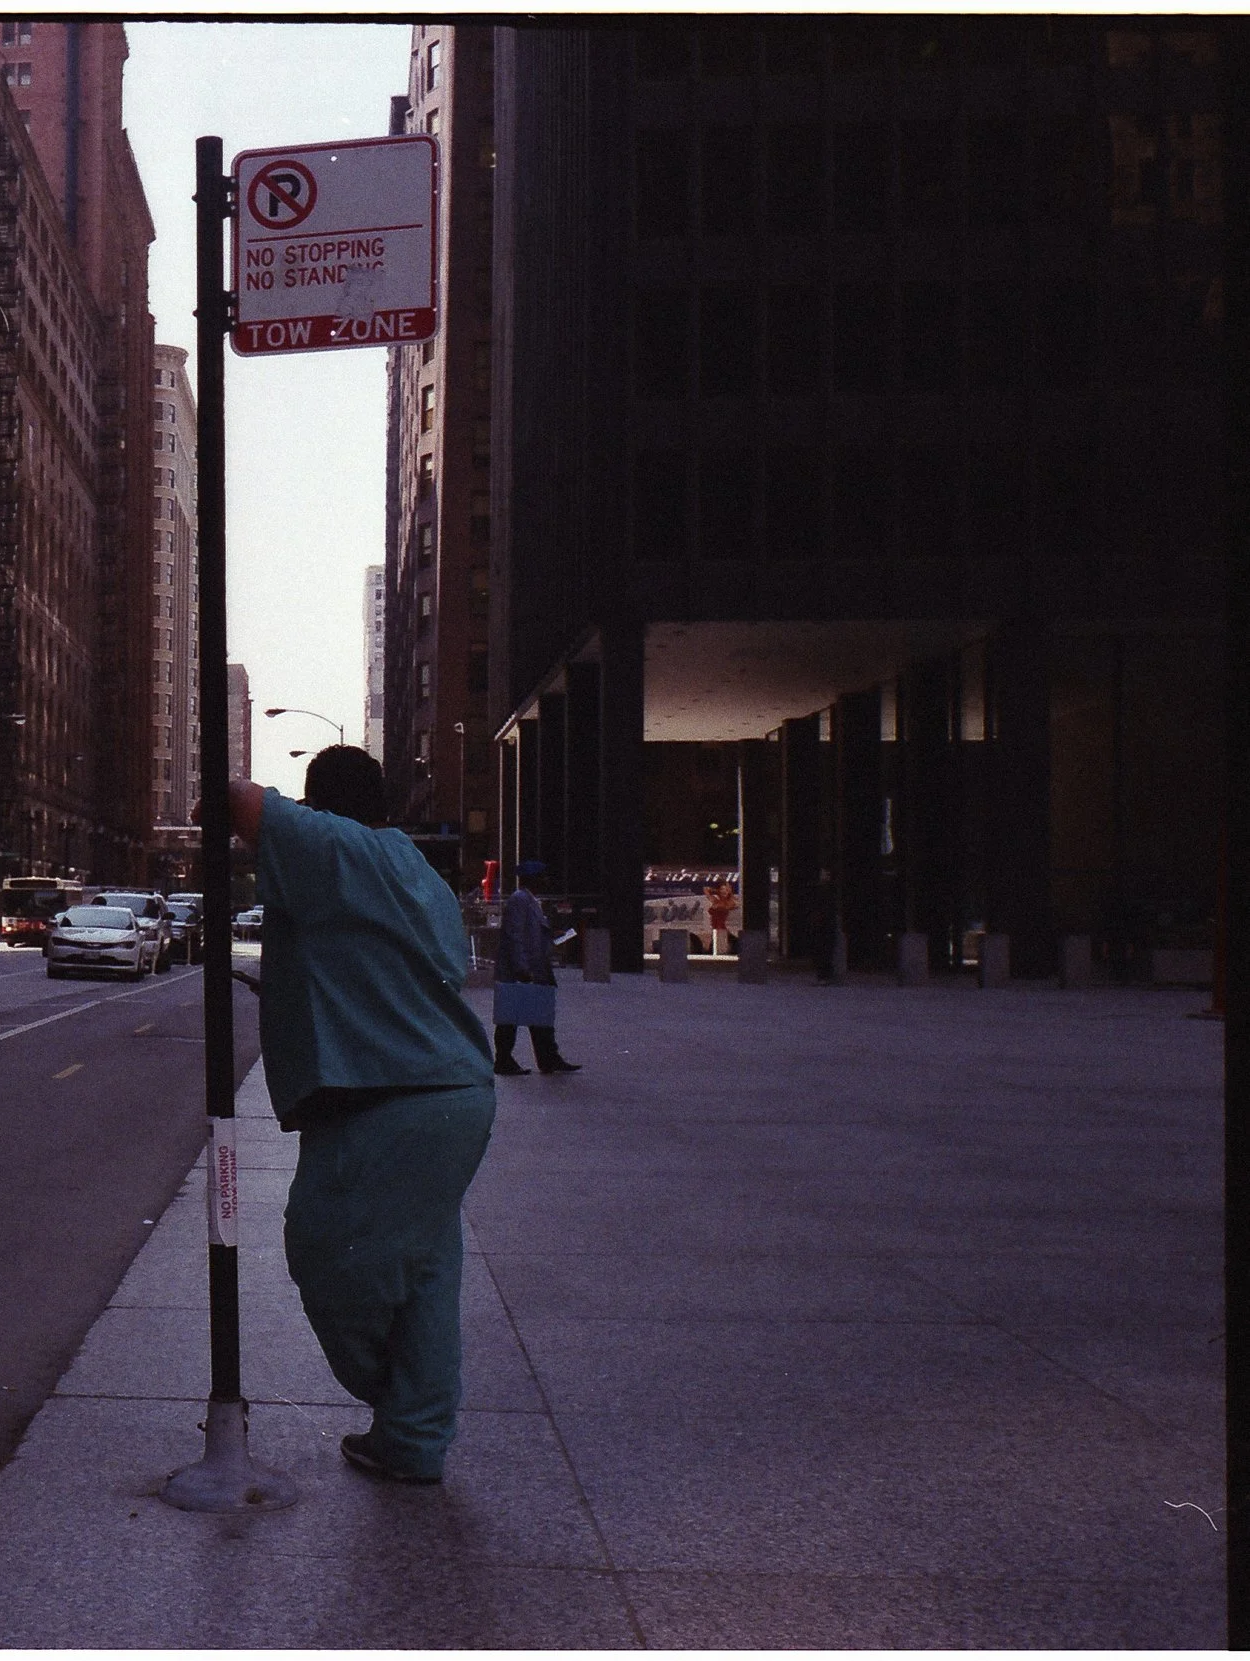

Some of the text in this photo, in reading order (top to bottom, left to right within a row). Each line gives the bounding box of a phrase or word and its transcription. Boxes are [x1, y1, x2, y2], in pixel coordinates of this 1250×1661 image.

[268, 173, 302, 218] P
[246, 237, 385, 267] NO STOPPING
[246, 261, 385, 291] NO STAND
[248, 312, 417, 348] TOW ZONE
[218, 1145, 231, 1219] NO PARKING
